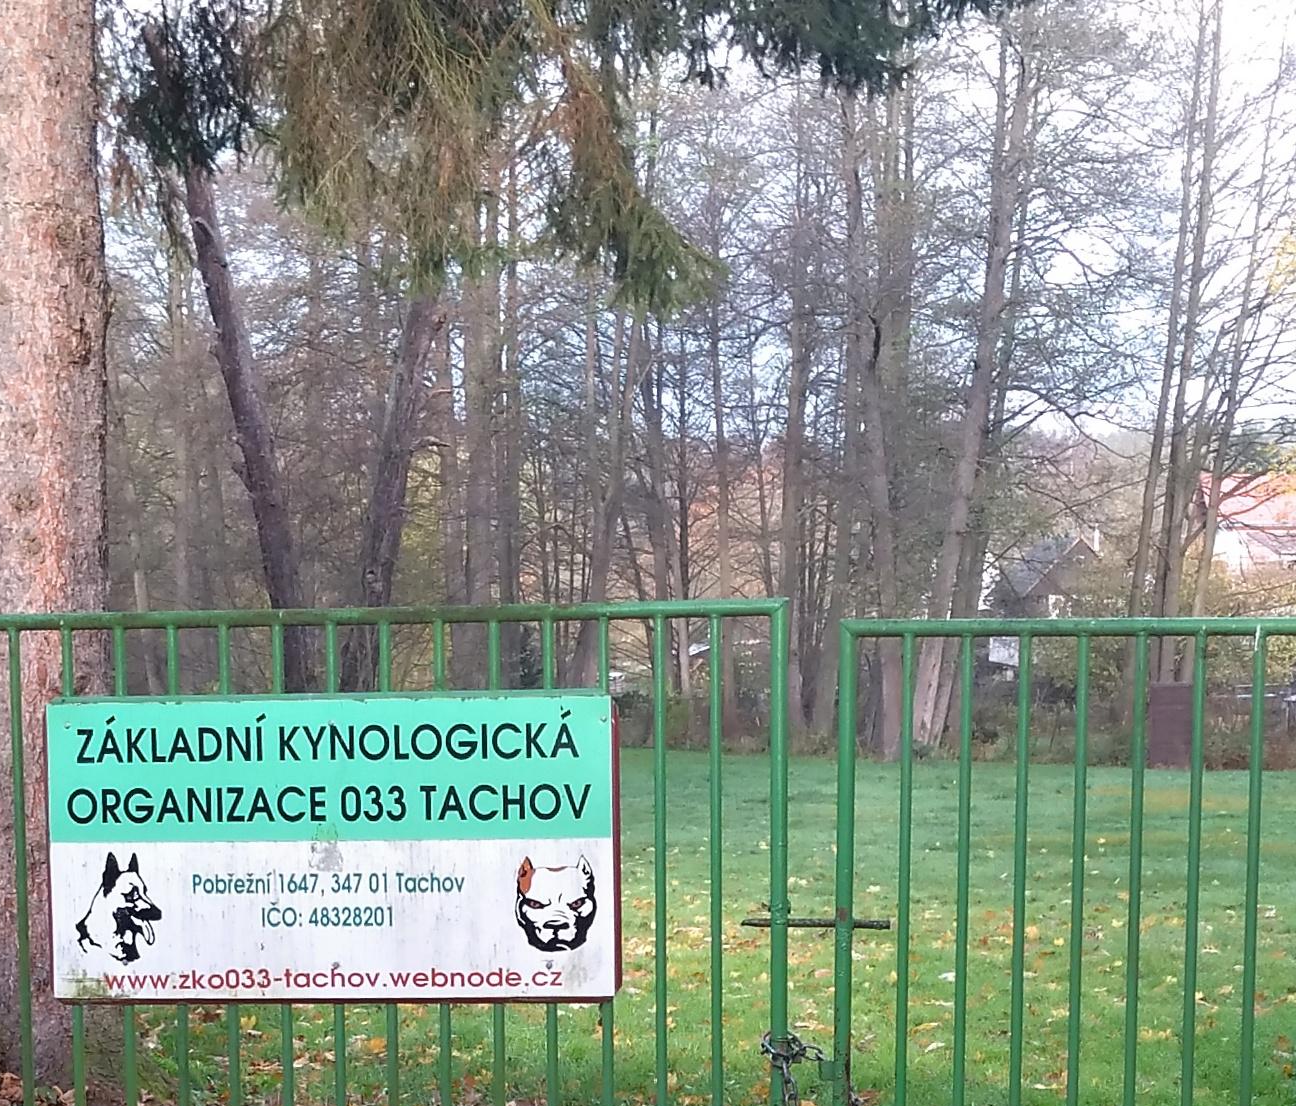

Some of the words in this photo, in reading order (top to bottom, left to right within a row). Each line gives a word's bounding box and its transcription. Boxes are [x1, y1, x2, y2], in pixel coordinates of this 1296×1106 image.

[75, 713, 266, 764] ZÁKLADNÍ
[278, 706, 580, 762] KYNOLOGICKÁ
[67, 785, 328, 825] ORGANIZACE
[340, 785, 407, 822] 033
[418, 783, 592, 821] TACHOV
[191, 872, 273, 895] Pobřežní
[278, 873, 325, 898] 1647,
[331, 873, 362, 894] 347
[367, 873, 389, 893] 01
[395, 872, 465, 894] Tachov
[260, 902, 304, 928] IČO:
[308, 905, 395, 928] 48328201
[104, 966, 563, 991] www.zko033-tachov.webnode.cz
